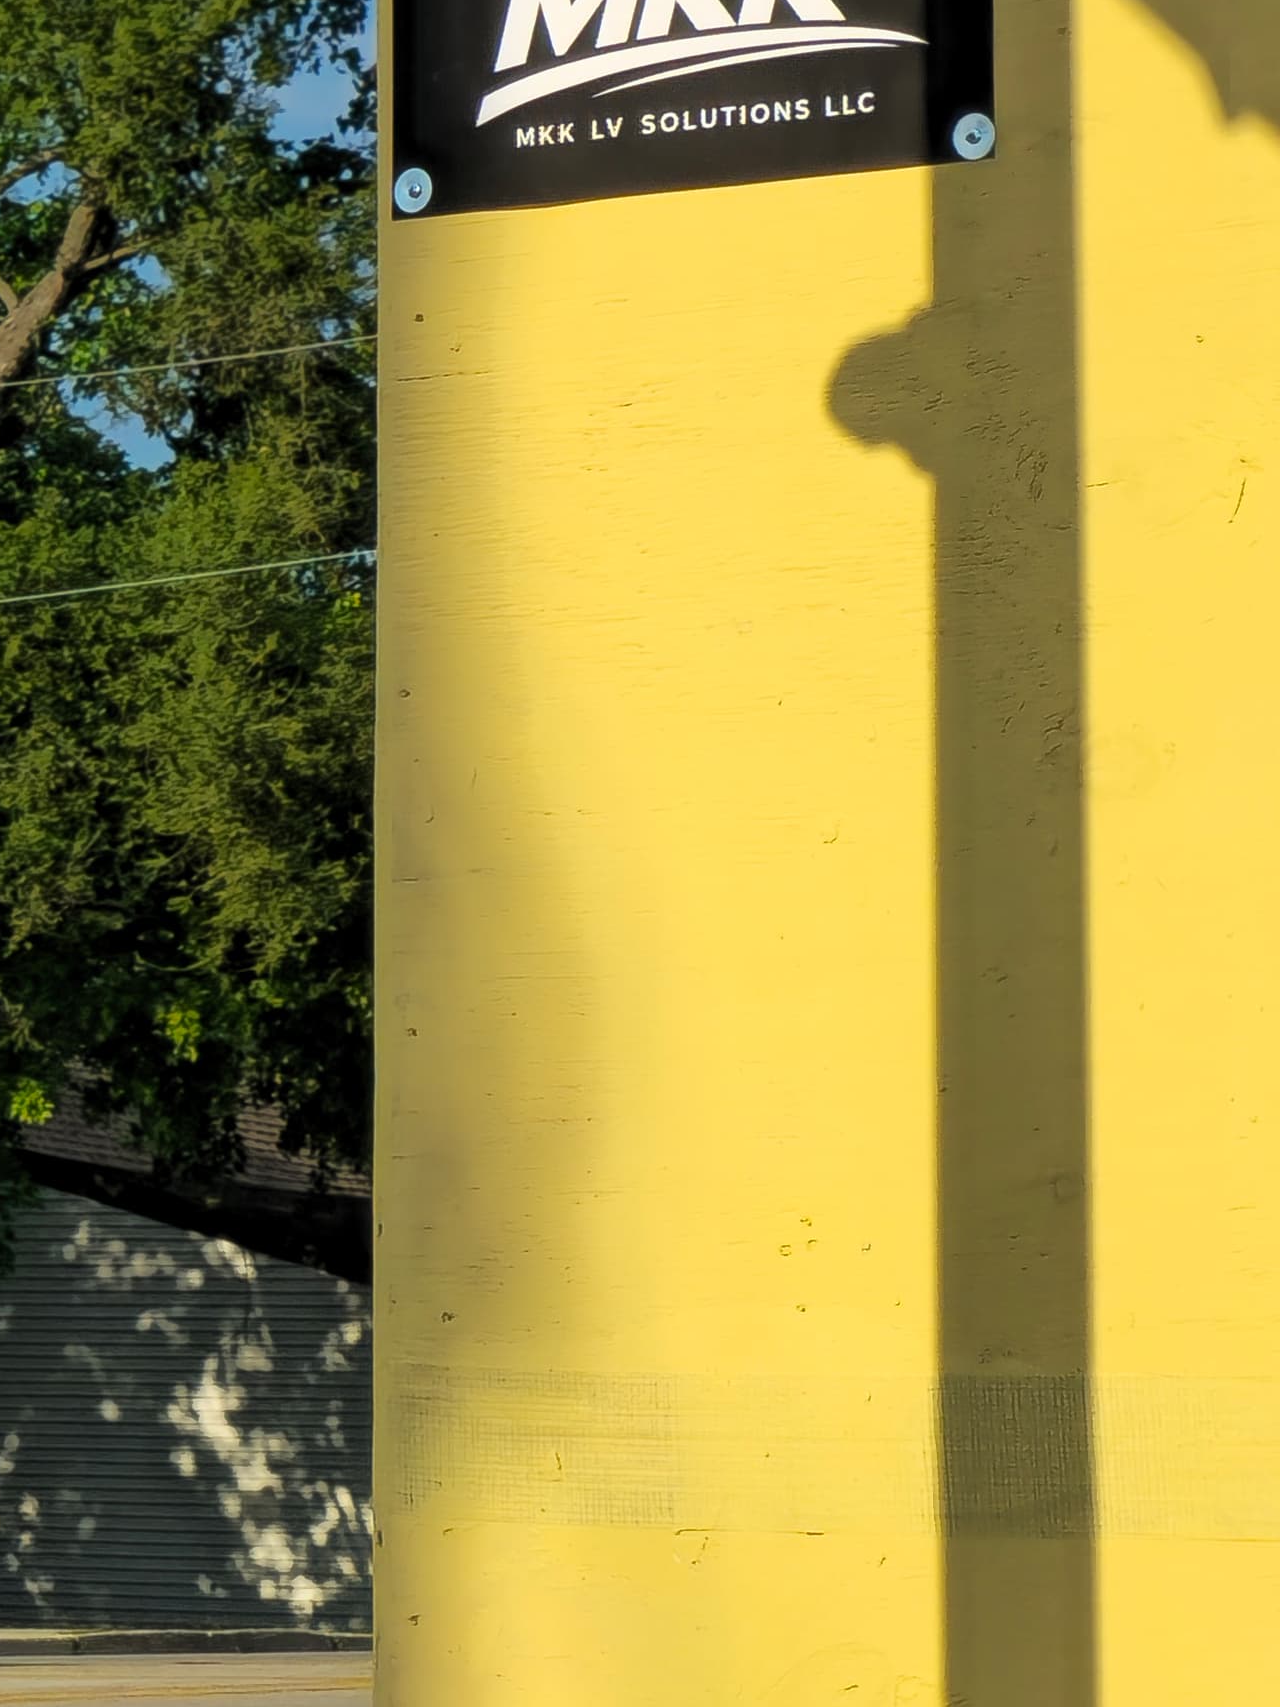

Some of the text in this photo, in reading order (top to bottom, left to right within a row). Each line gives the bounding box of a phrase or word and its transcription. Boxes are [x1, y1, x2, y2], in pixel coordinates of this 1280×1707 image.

[515, 91, 876, 149] MKK LV SOLUTIONS LLC
